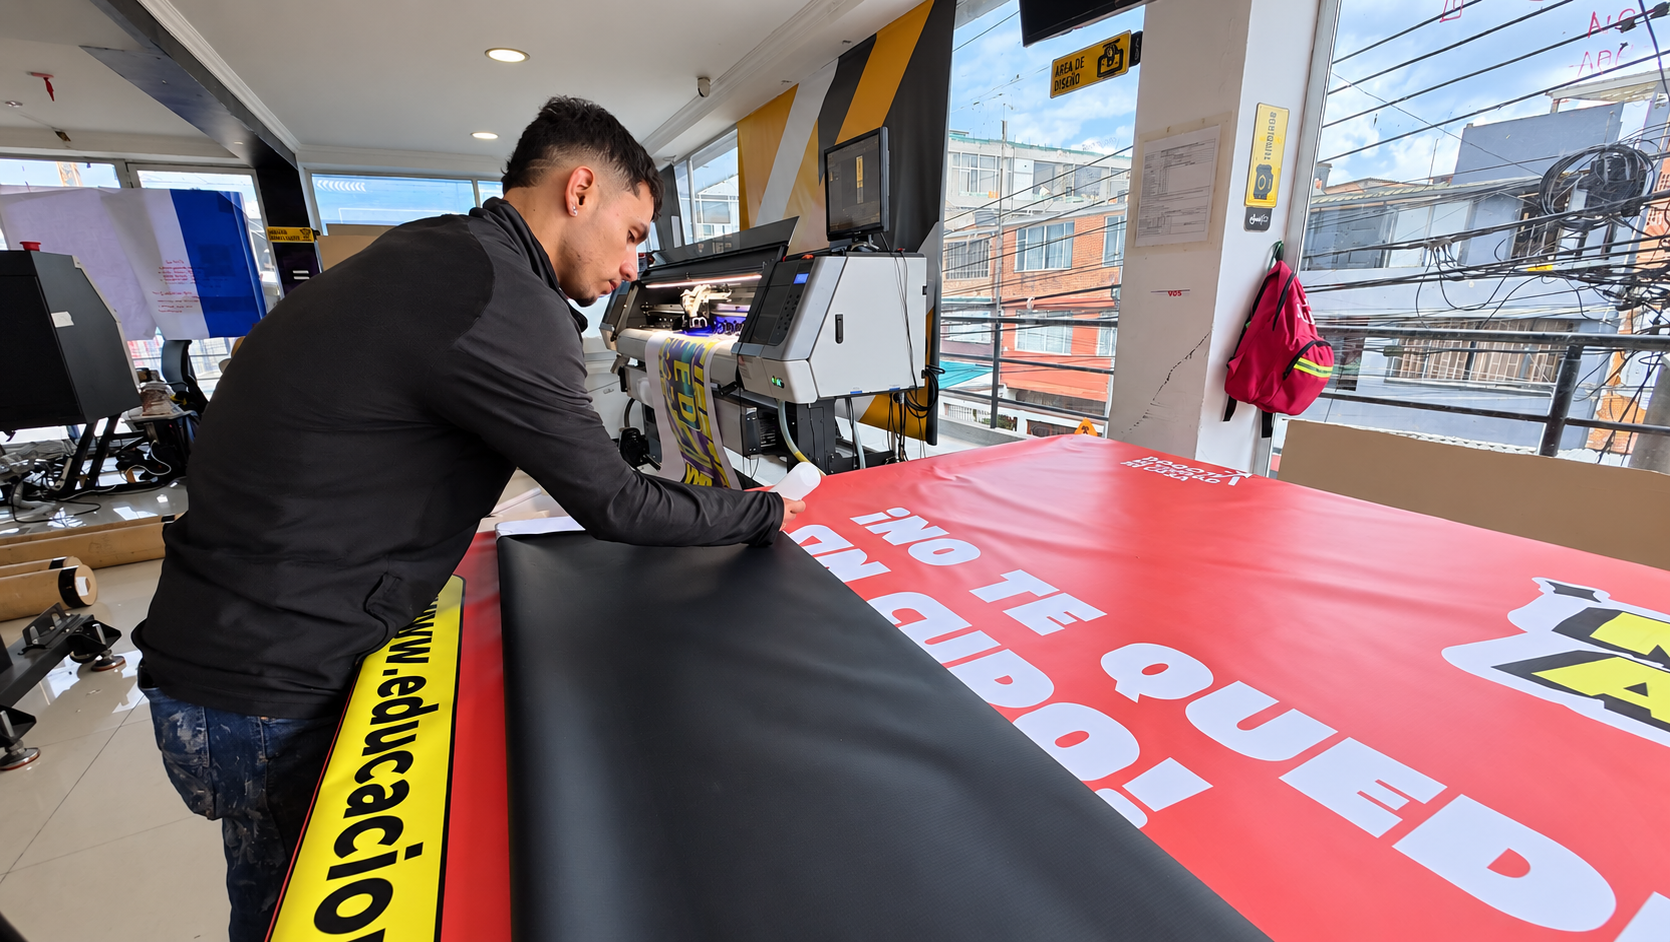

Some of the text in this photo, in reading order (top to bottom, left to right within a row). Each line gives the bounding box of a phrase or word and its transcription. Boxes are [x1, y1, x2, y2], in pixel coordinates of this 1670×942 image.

[1075, 56, 1085, 70] DE
[969, 569, 1108, 636] TE
[313, 598, 439, 942] ww.educacio
